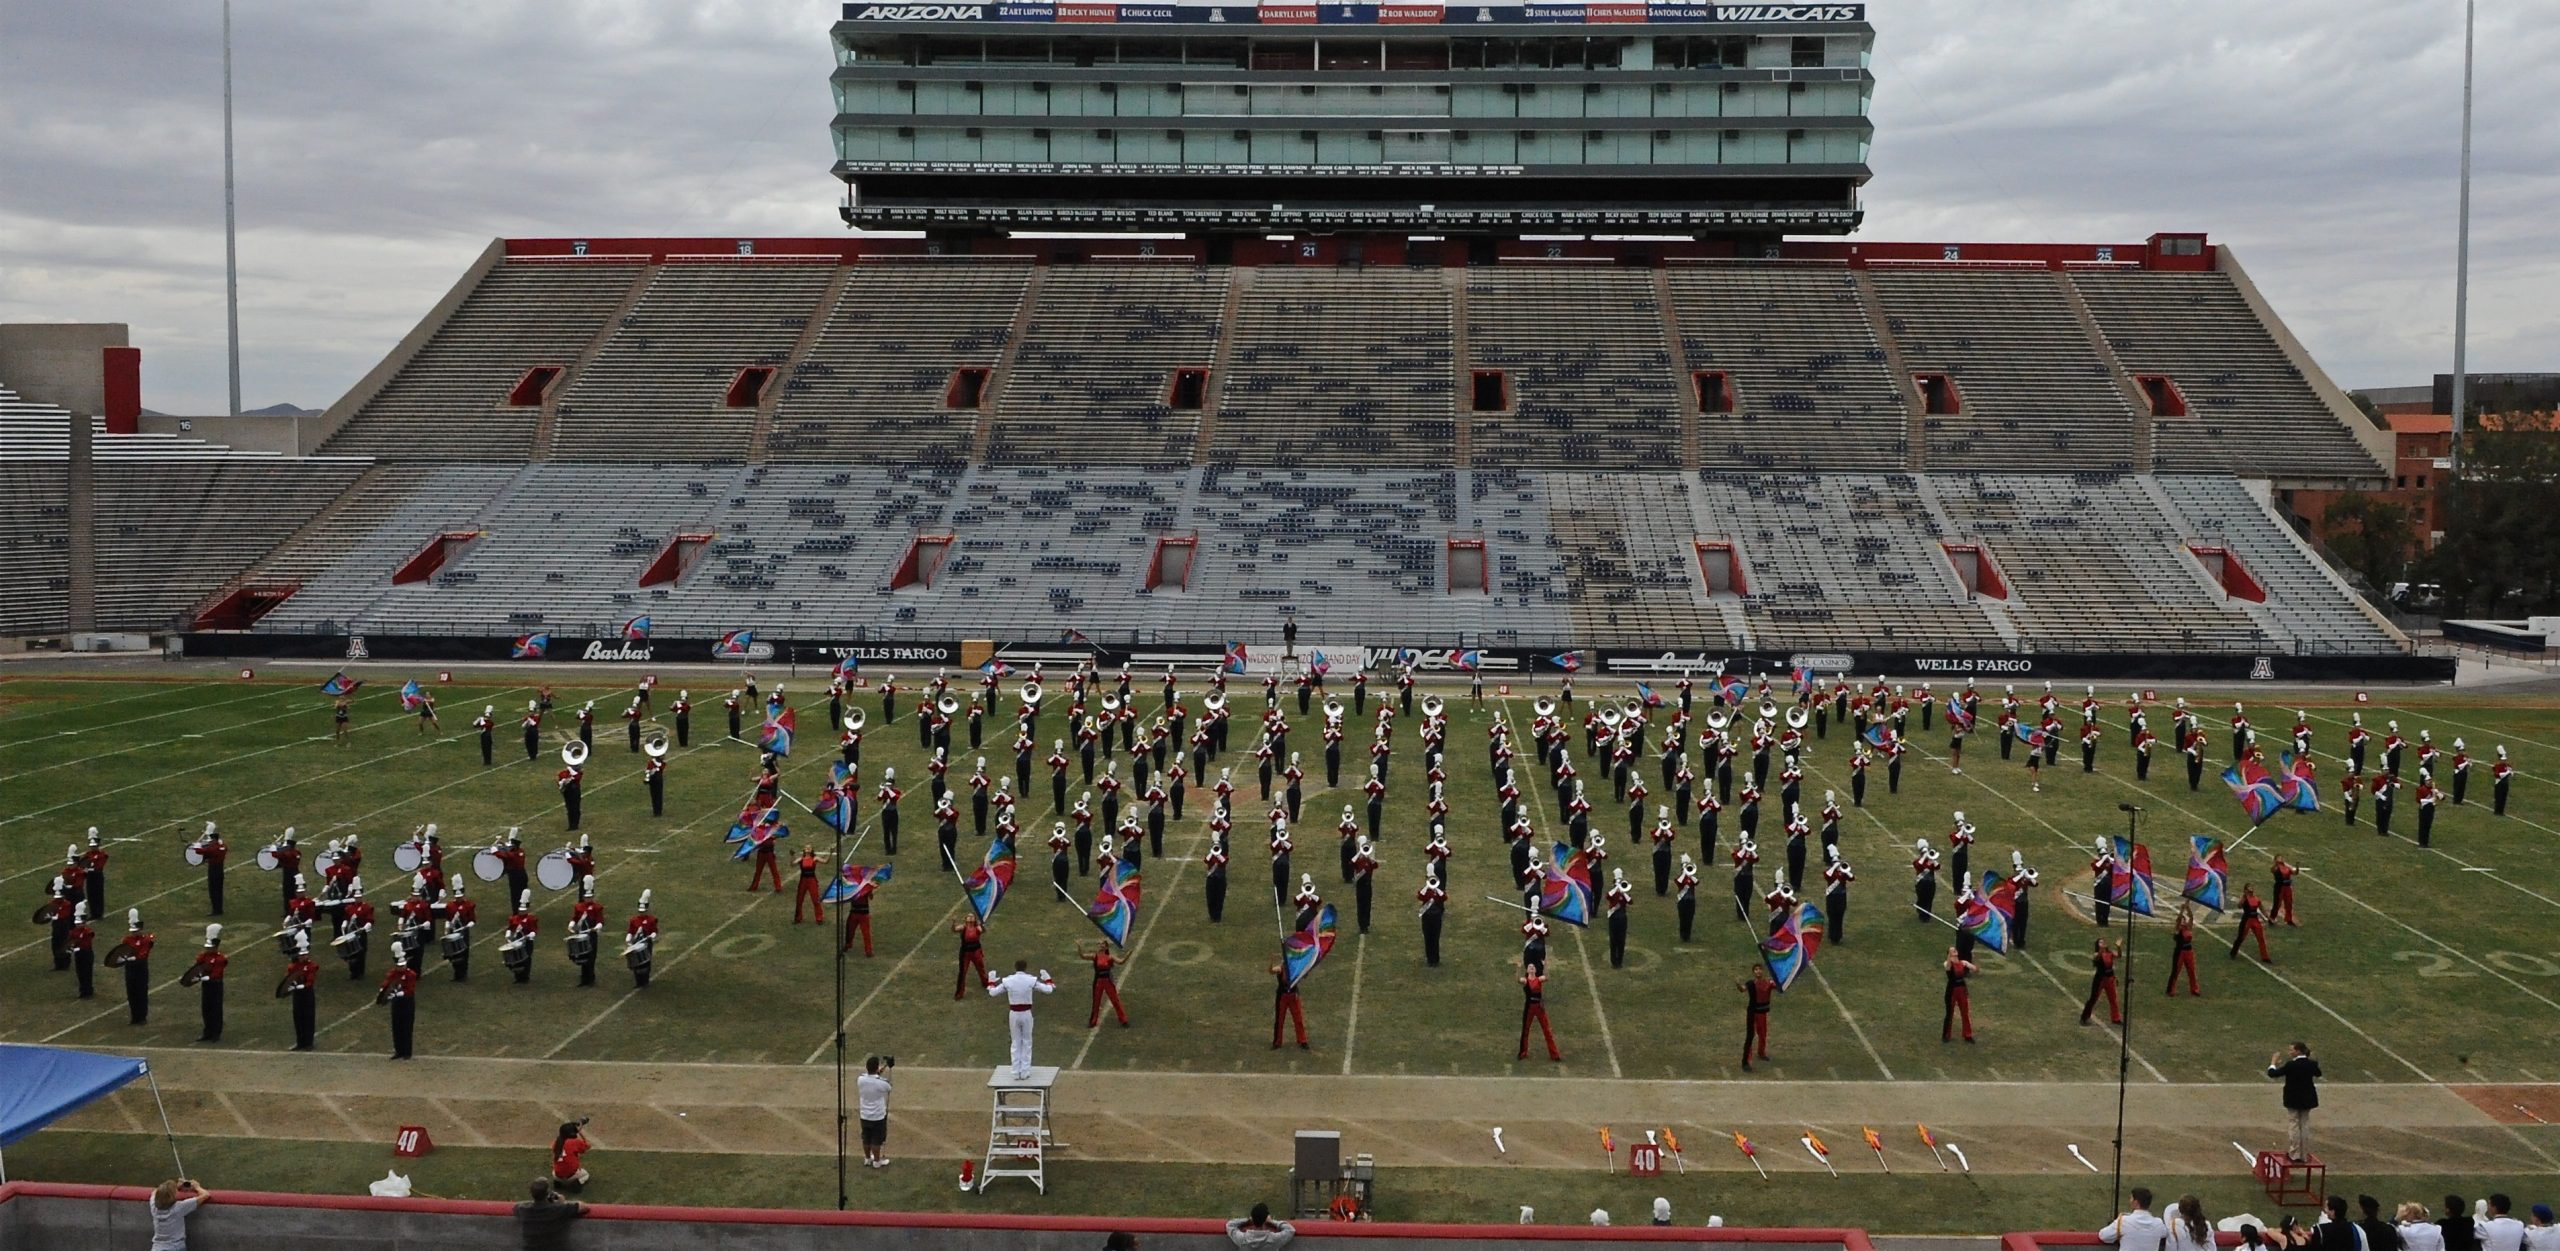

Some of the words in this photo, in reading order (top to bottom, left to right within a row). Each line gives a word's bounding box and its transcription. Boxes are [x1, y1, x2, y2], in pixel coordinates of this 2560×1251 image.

[857, 6, 983, 20] ARIZONA
[1000, 7, 1008, 16] 22
[1009, 8, 1021, 16] ART
[1023, 8, 1053, 16] LUPPINO
[1067, 8, 1088, 16] RICKY
[1089, 8, 1115, 17] HUNLEY
[1127, 9, 1151, 17] CHUCK
[1153, 9, 1173, 17] CECIL
[1264, 10, 1294, 18] DARRYLL
[1535, 9, 1549, 17] STEVE
[1551, 9, 1585, 17] McLAUGHLIN
[1613, 9, 1646, 17] McALISTER
[1654, 9, 1682, 17] ANTOINE
[1684, 9, 1706, 17] CASON
[1716, 6, 1857, 20] WILDCATS
[575, 246, 586, 255] 17
[739, 245, 752, 255] 18
[928, 246, 940, 255] 19
[1140, 246, 1155, 255] 20
[1302, 246, 1315, 257] 21
[1547, 247, 1562, 257] 22
[1766, 249, 1780, 258] 23
[1944, 250, 1958, 260] 24
[2097, 251, 2111, 261] 25
[180, 421, 192, 430] 16
[583, 641, 654, 660] Bashas'
[833, 648, 889, 659] WELLS
[894, 648, 948, 659] FARGO
[1813, 659, 1848, 667] CASINOS
[1915, 659, 1973, 671] WELLS
[1976, 659, 2032, 671] FARGO
[398, 1130, 419, 1152] 40
[1634, 1149, 1656, 1171] 40
